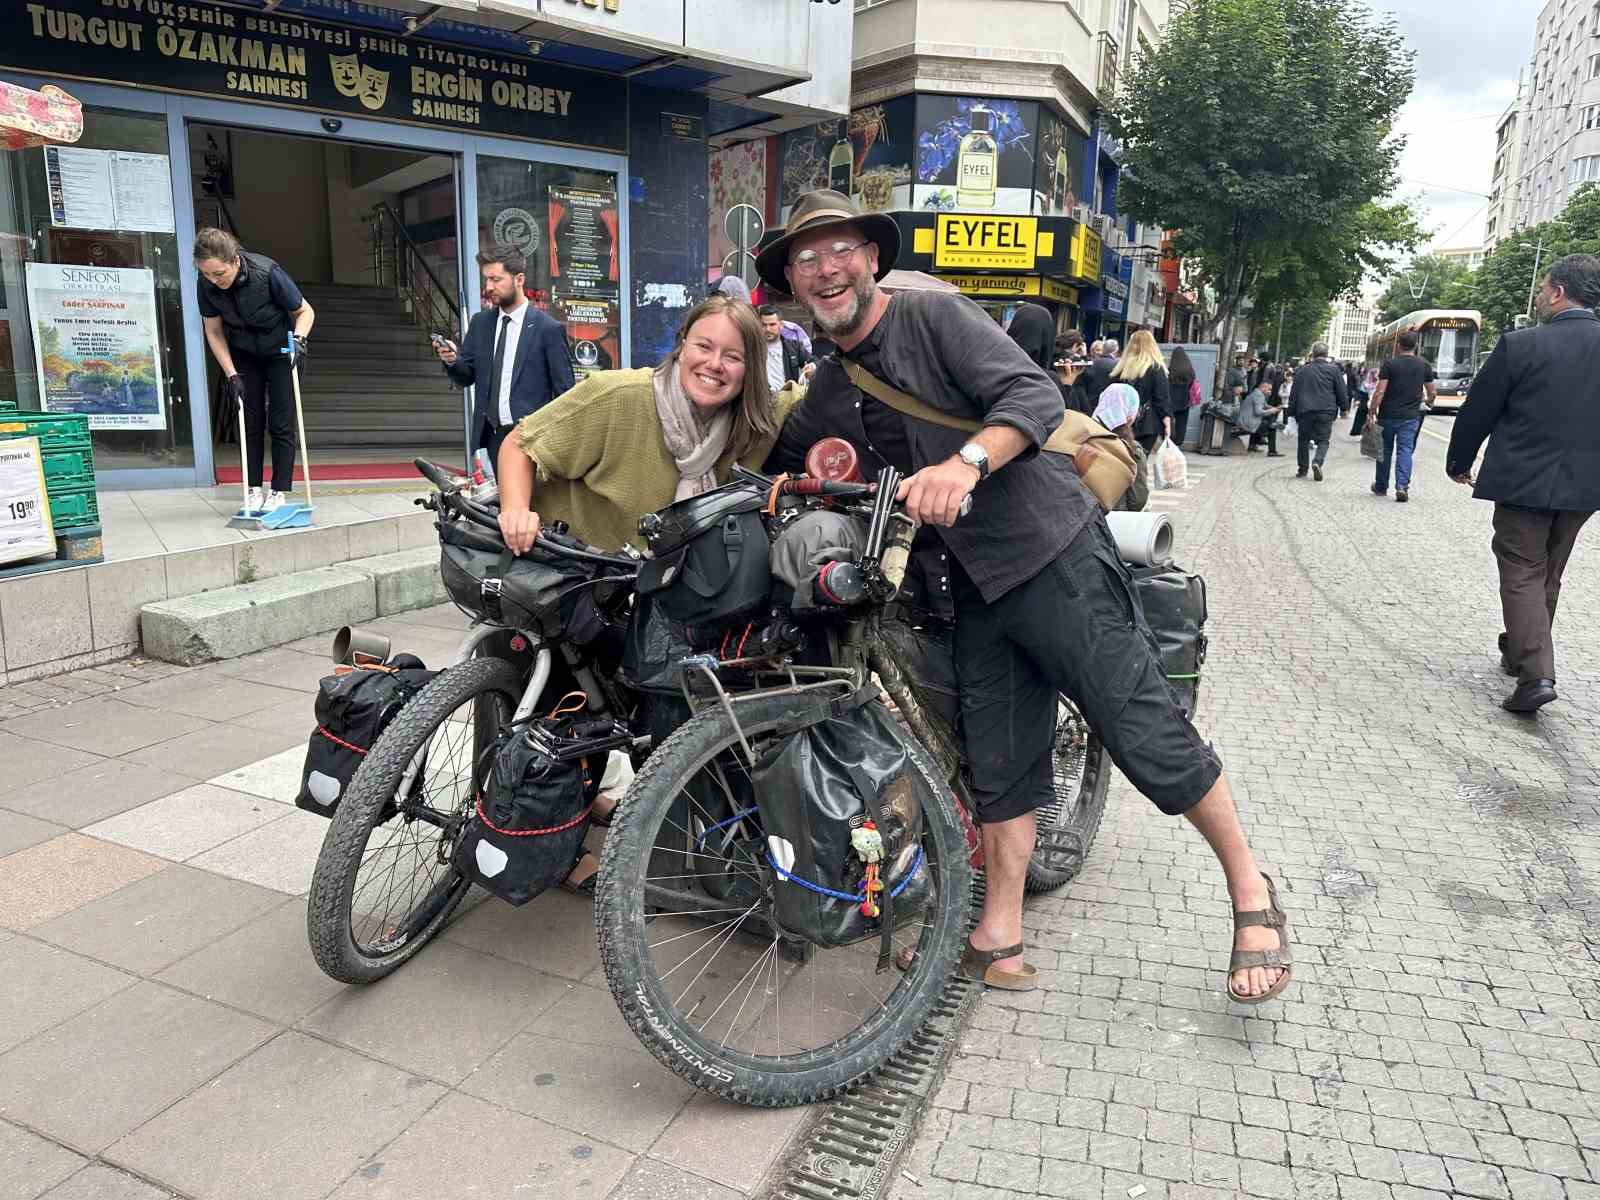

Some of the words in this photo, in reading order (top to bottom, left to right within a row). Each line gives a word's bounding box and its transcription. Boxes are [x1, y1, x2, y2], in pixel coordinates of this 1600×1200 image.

[26, 3, 143, 51] TURGUT
[157, 18, 306, 76] ÖZAKMAN
[246, 15, 350, 46] BELEDİYESİ
[359, 36, 408, 56] ŞEHİR
[417, 44, 527, 77] TİYATROLARI
[226, 71, 308, 100] SAHNESİ
[410, 66, 483, 104] ERGİN
[491, 80, 572, 116] ORBEY
[412, 98, 480, 125] SAHNESİ
[963, 164, 991, 176] EYFEL
[945, 219, 1027, 248] EYFEL
